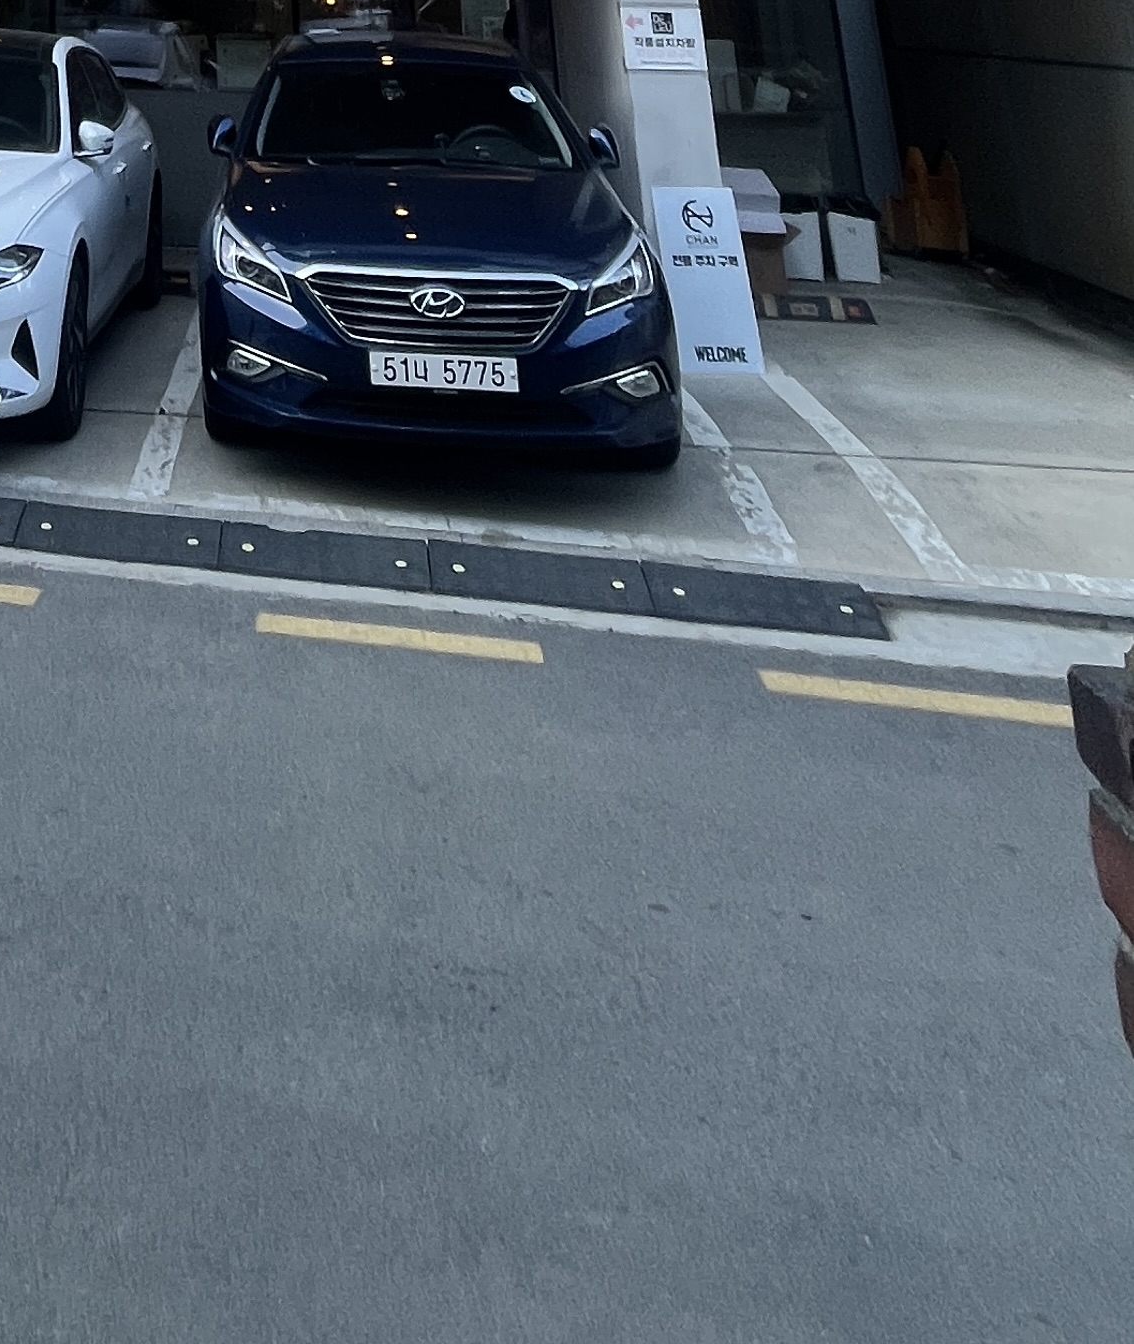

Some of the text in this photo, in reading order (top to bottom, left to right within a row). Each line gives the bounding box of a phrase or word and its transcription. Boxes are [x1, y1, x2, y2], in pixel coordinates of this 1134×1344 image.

[685, 234, 718, 245] CHAN
[694, 345, 749, 364] WELCOME
[442, 359, 506, 387] 5775
